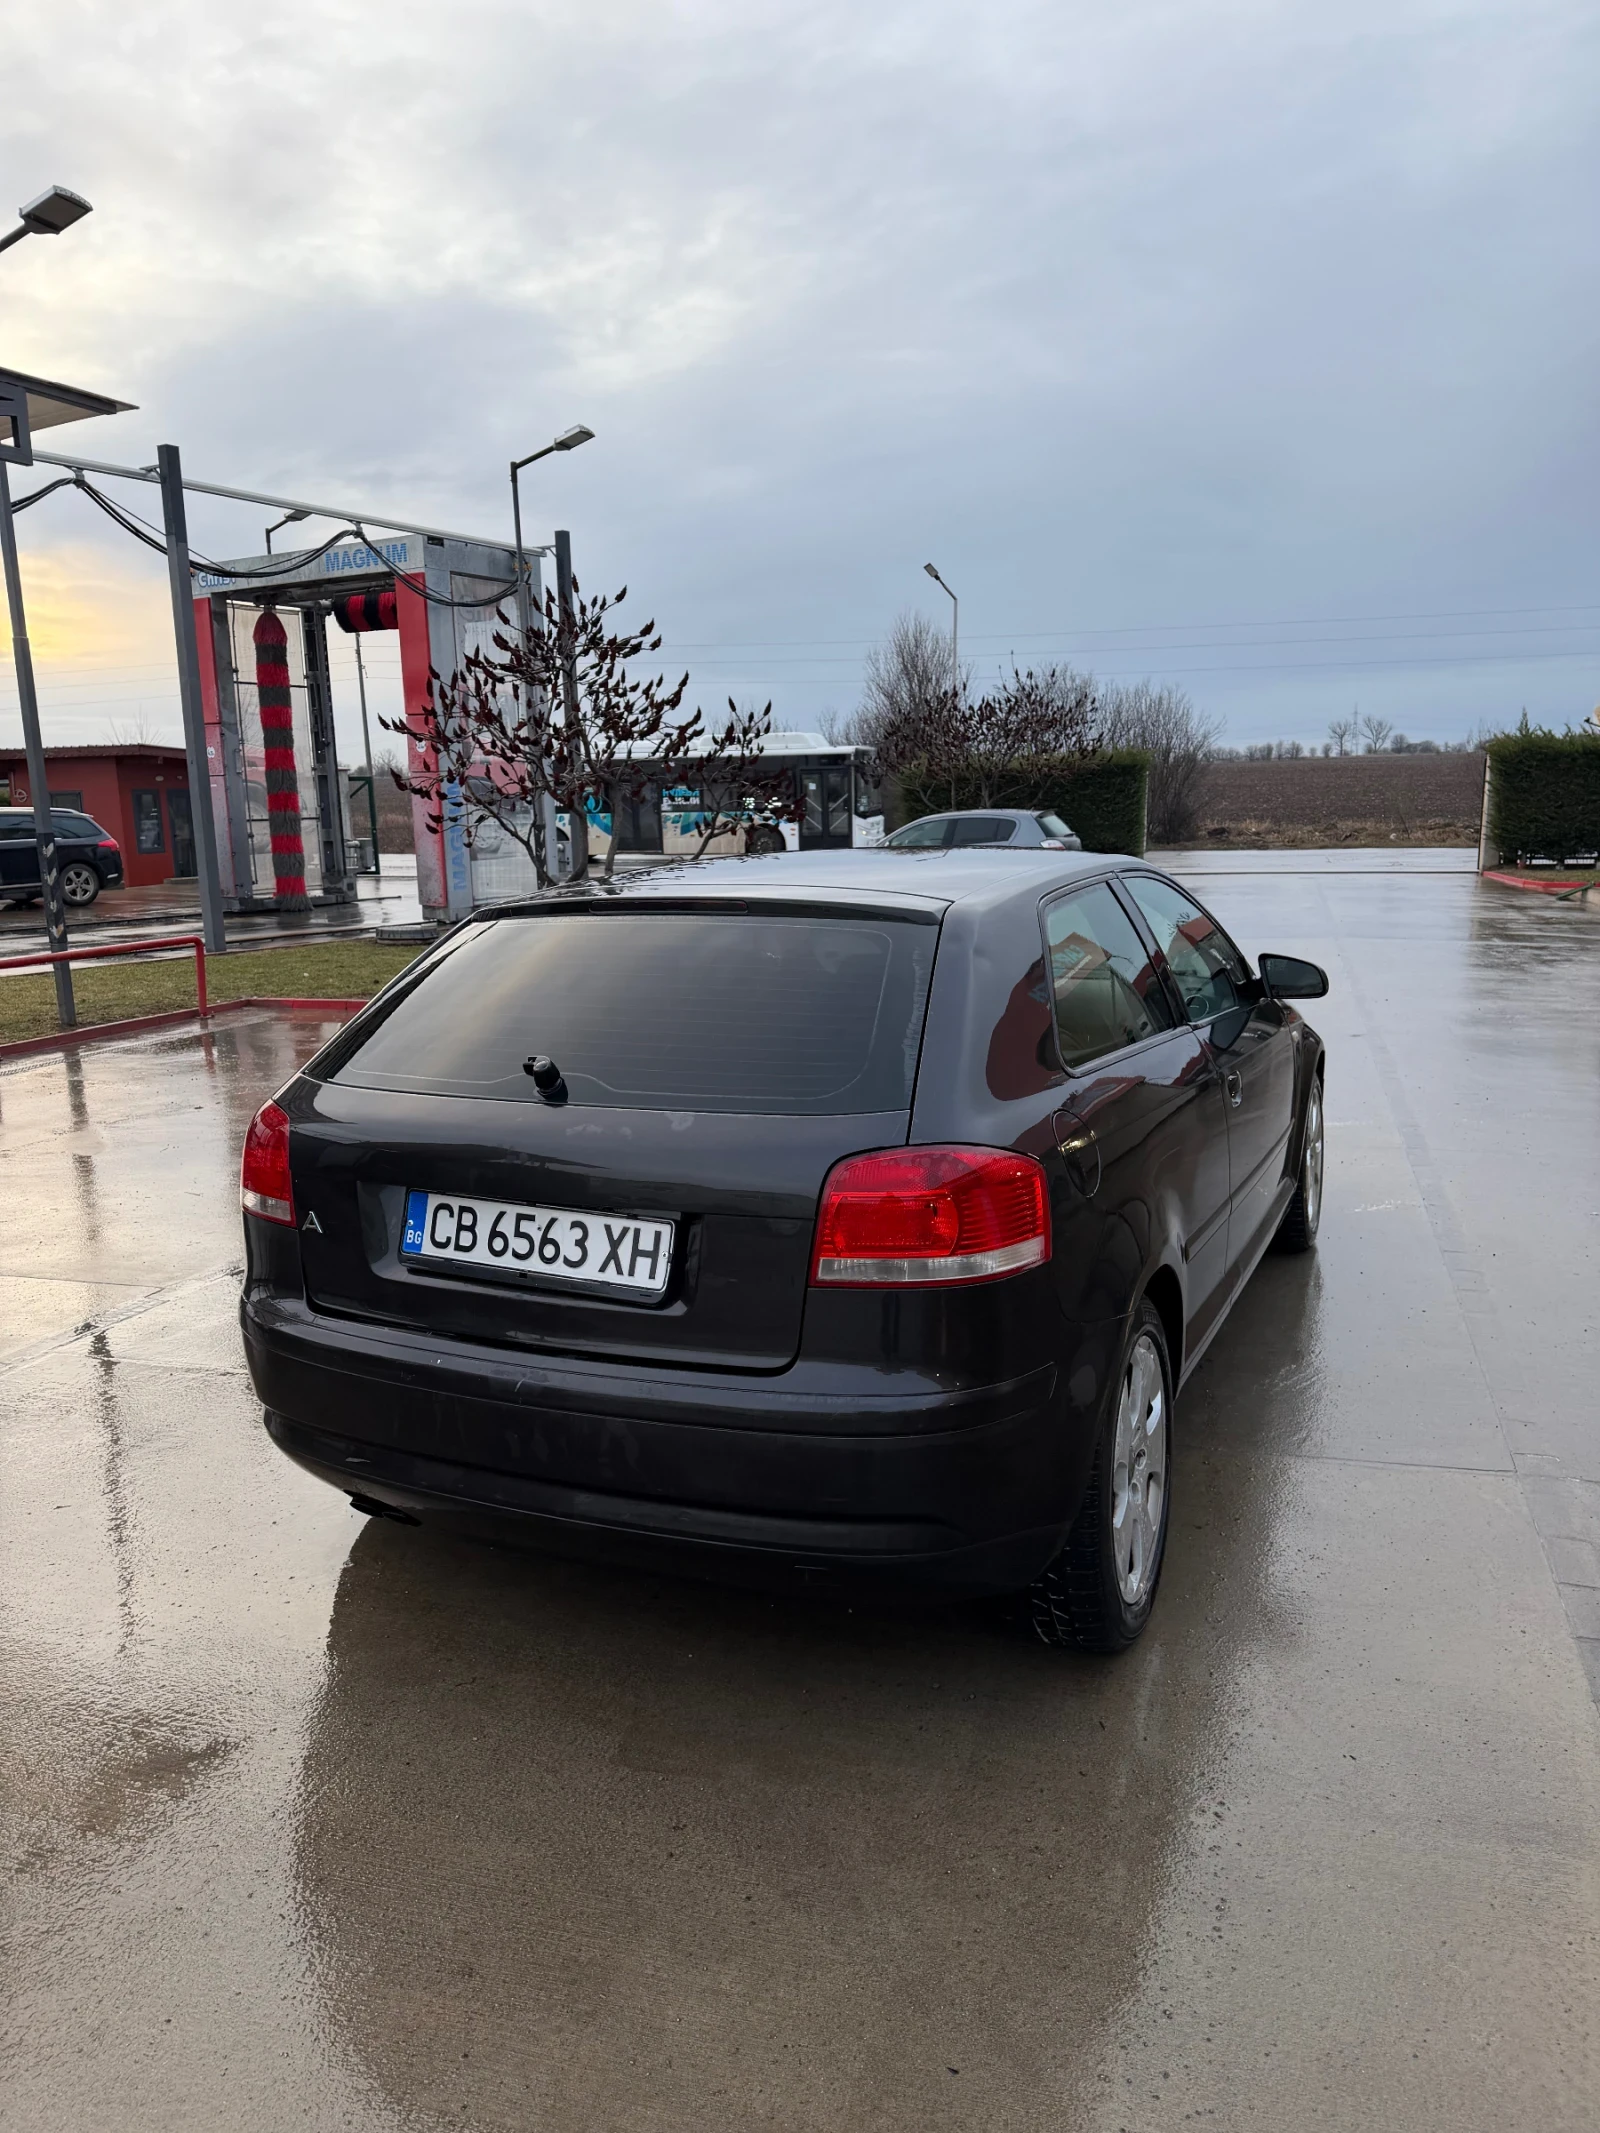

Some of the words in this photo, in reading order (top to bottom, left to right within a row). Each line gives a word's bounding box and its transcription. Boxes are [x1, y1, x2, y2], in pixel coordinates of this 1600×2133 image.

[325, 543, 408, 572] MAGNUM
[406, 1229, 424, 1245] BG
[430, 1203, 478, 1252] CB
[488, 1211, 590, 1269] 6563
[598, 1224, 662, 1280] XH
